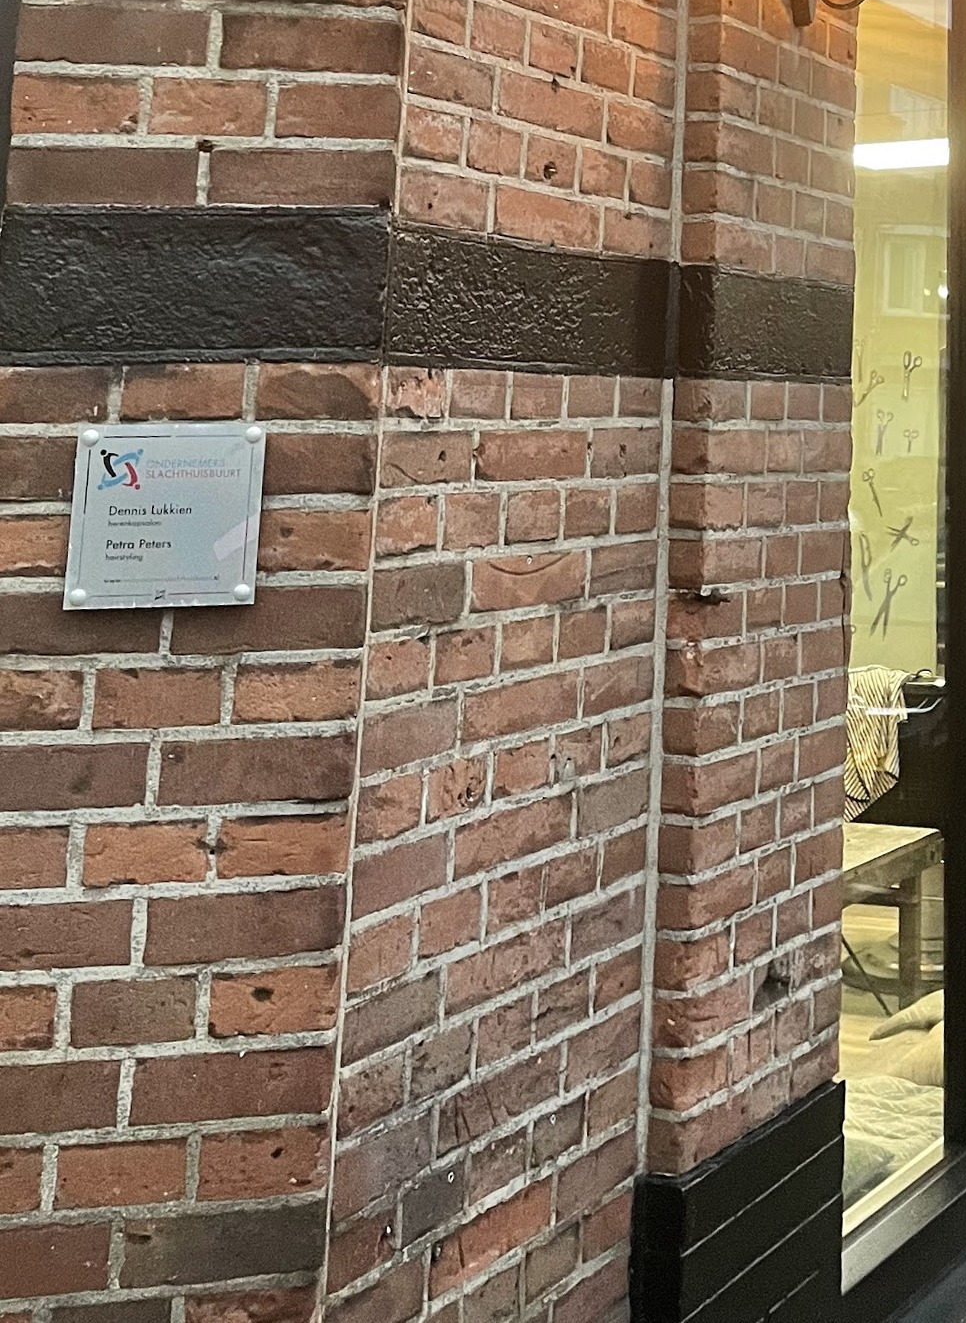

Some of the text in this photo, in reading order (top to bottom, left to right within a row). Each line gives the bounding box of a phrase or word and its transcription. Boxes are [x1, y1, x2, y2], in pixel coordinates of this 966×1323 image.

[146, 458, 225, 469] ONDERNEMERS
[146, 469, 241, 479] SLACHTHUISBUURT
[109, 503, 192, 515] Dennis Lukkien
[105, 538, 172, 549] Petra Peters
